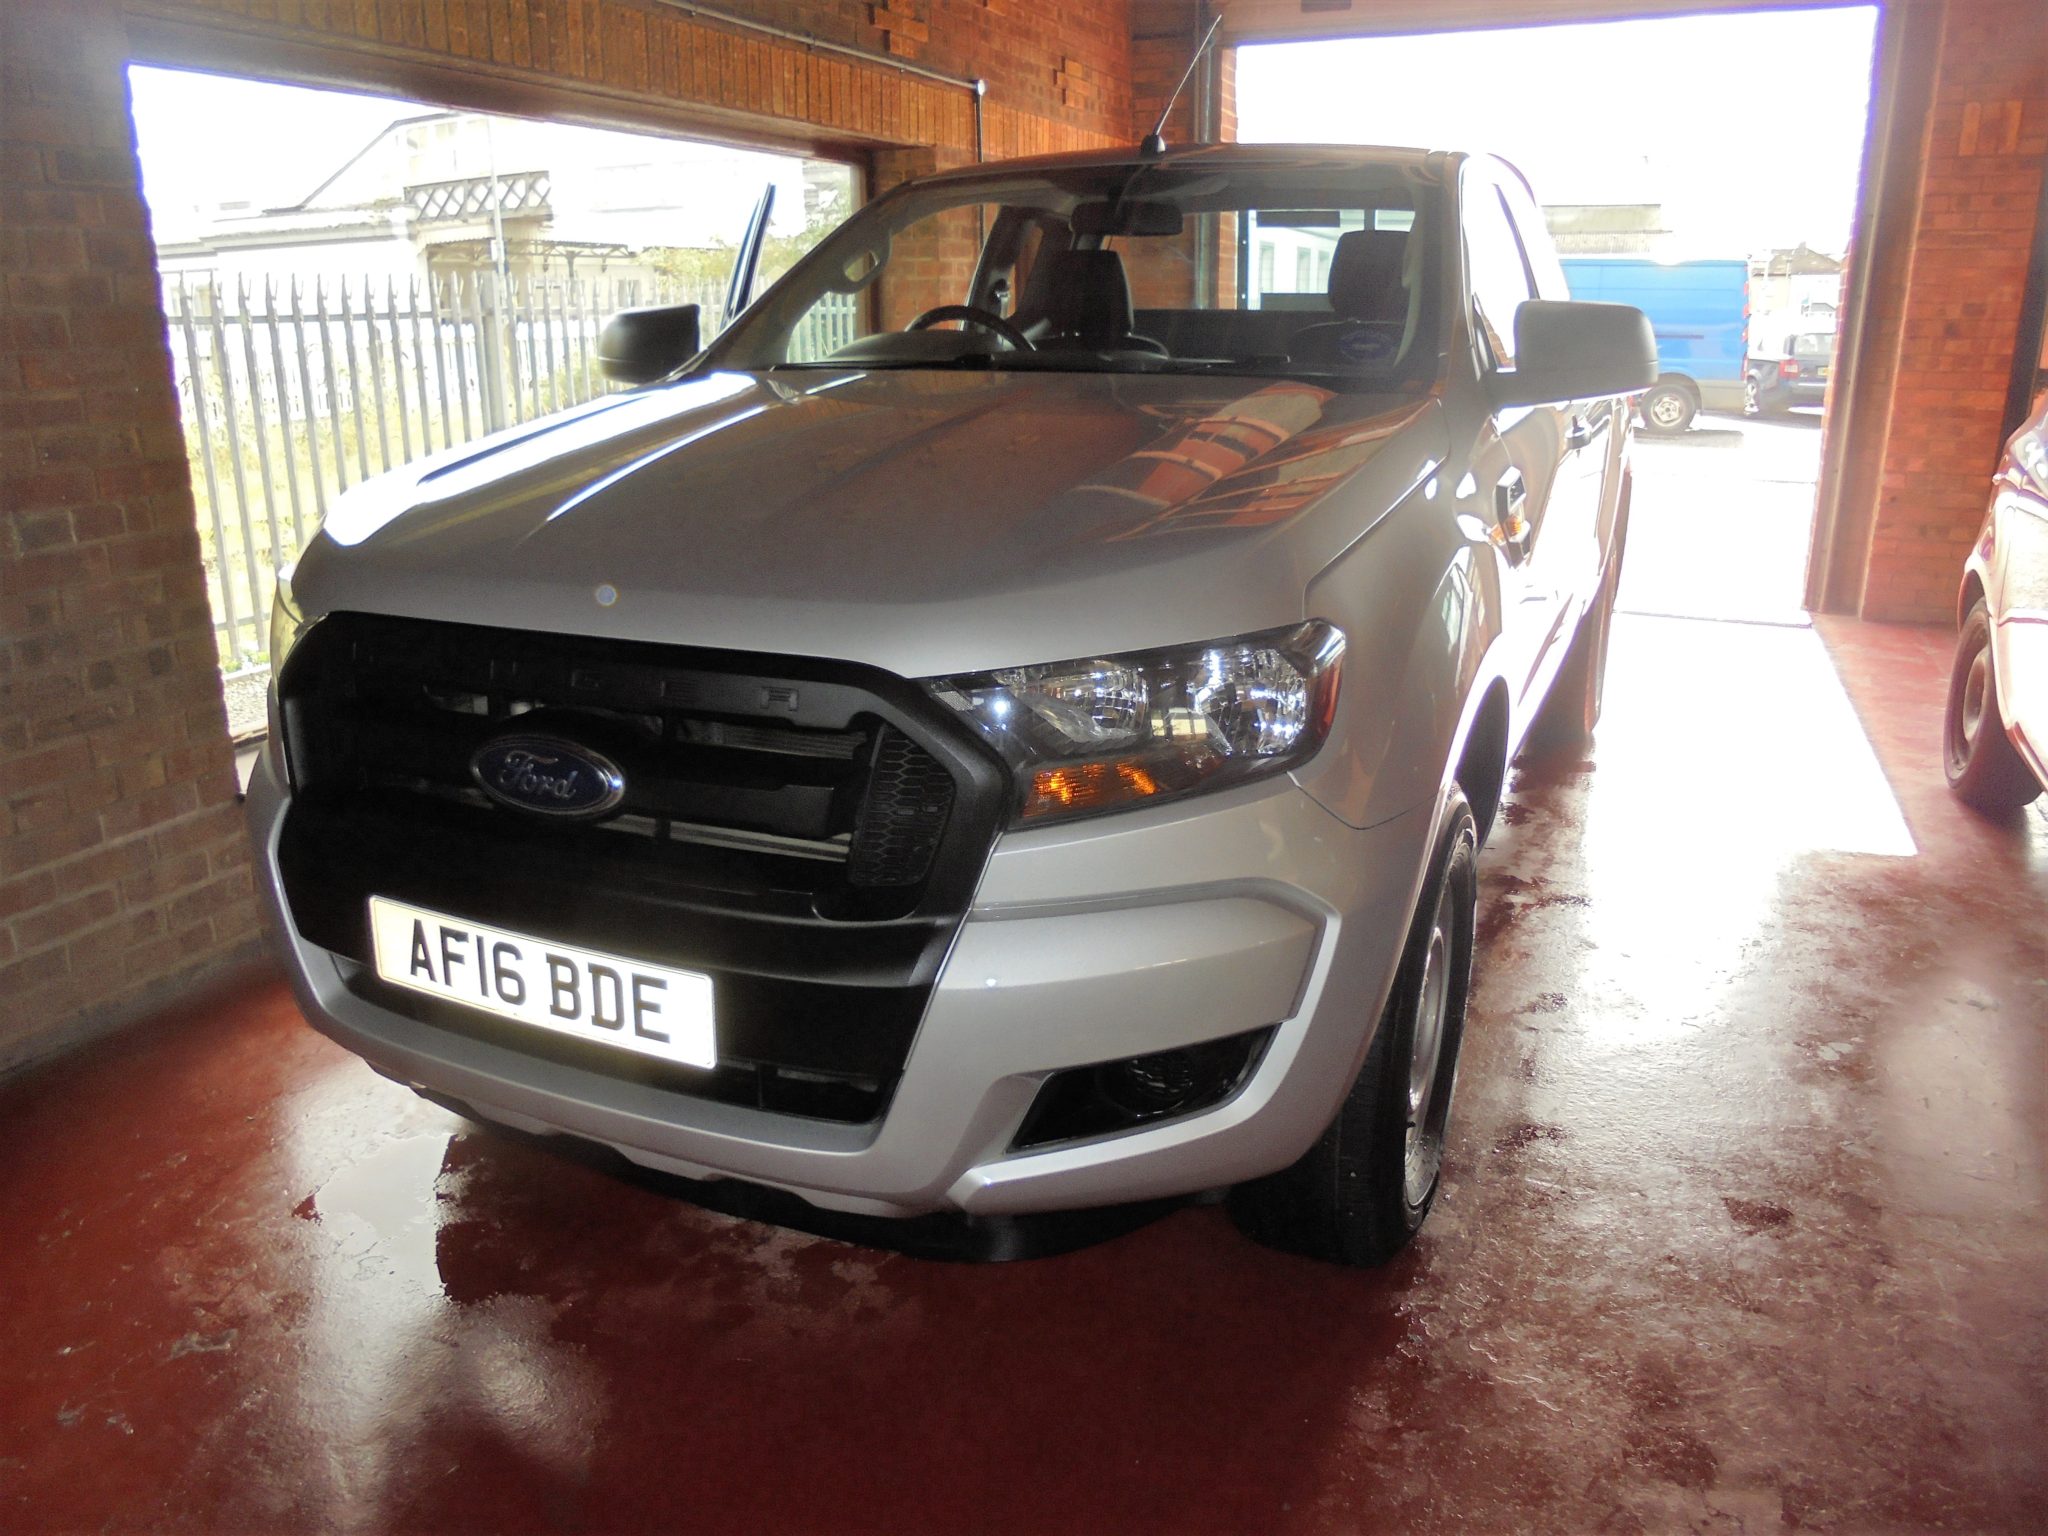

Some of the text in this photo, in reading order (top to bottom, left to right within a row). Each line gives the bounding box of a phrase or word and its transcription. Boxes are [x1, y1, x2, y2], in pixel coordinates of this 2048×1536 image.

[497, 749, 579, 800] Ford
[410, 918, 670, 1044] AF16 BDE
